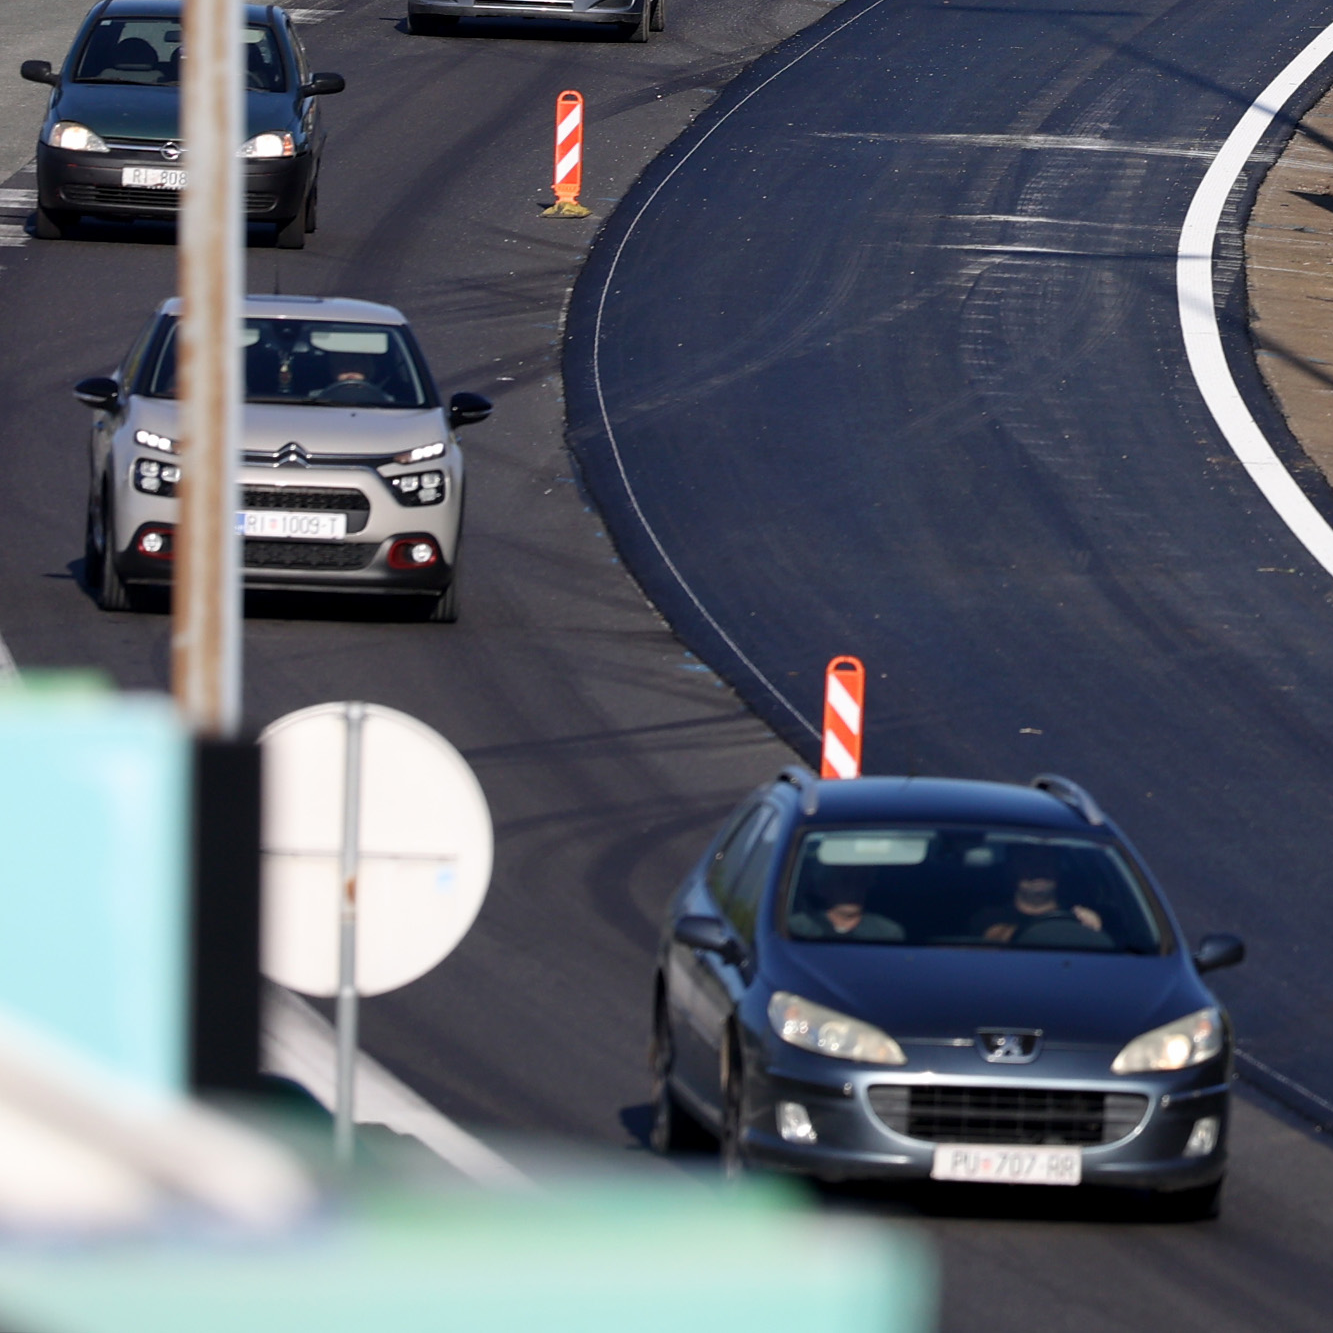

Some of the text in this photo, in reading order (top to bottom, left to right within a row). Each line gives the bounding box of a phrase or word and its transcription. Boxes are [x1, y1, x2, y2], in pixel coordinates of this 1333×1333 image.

[133, 169, 188, 185] RI 808
[247, 516, 265, 533] RI
